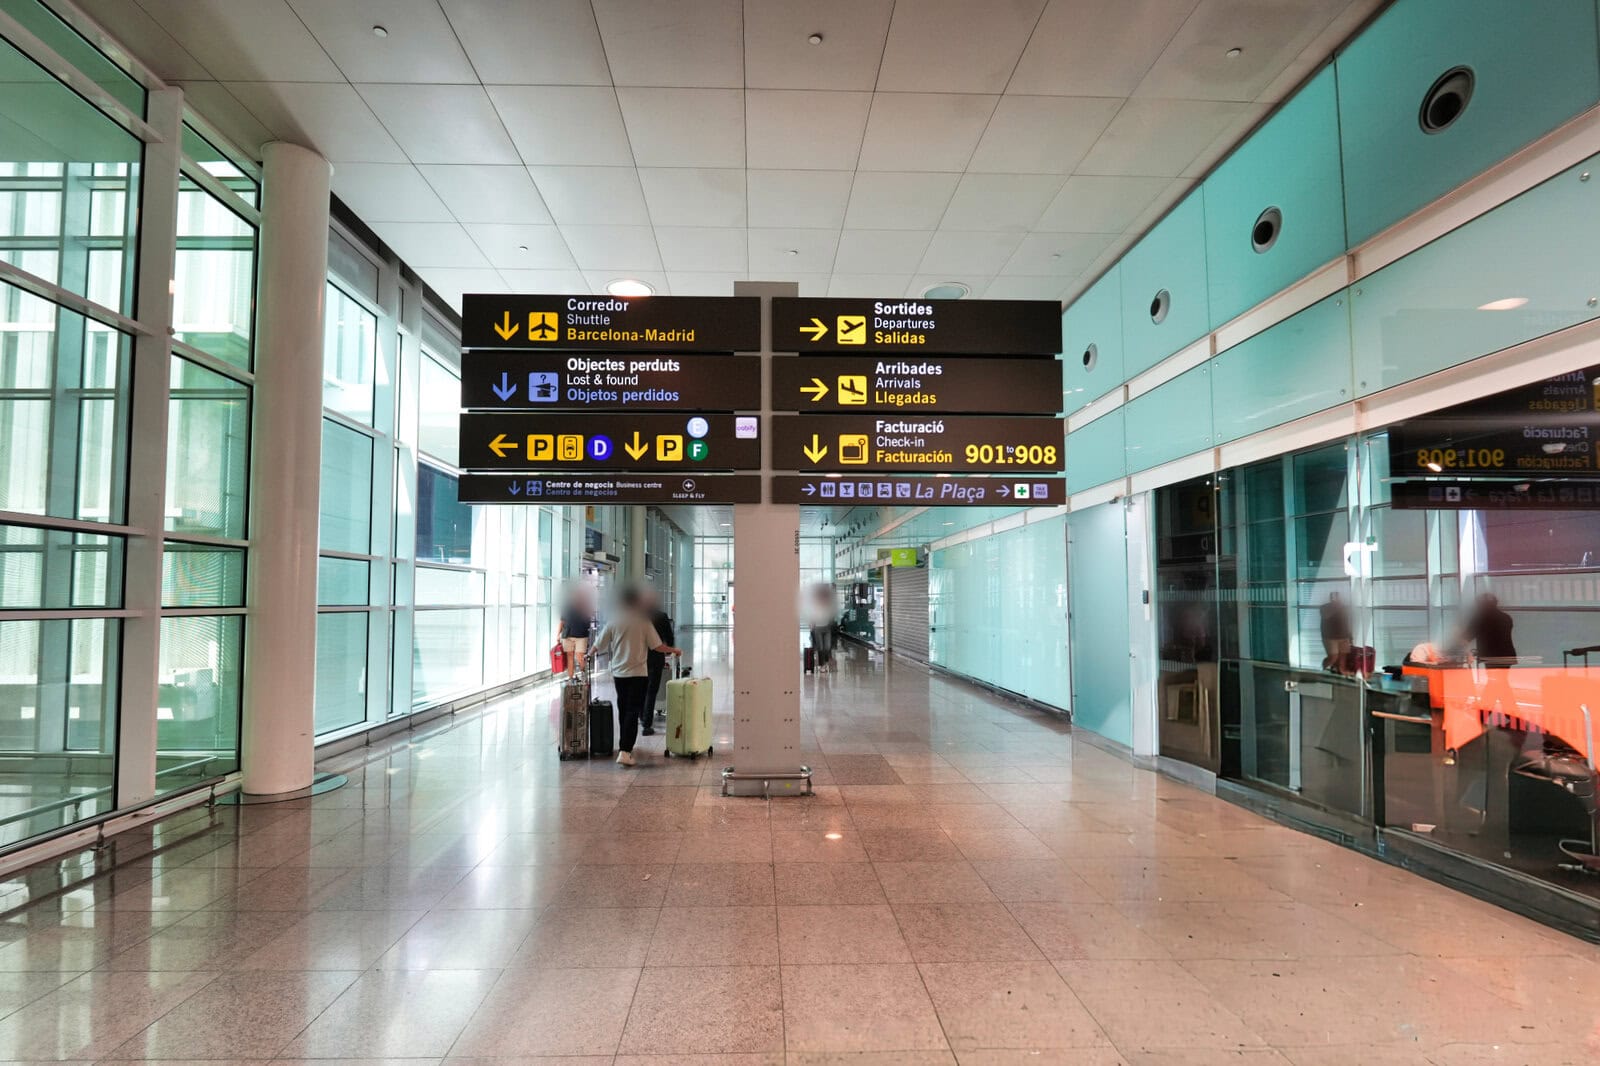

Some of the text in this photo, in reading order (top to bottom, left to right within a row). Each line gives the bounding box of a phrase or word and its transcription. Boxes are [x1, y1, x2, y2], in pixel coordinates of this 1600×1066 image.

[567, 298, 629, 311] Corredor
[875, 302, 932, 315] Sortides
[567, 314, 610, 325] Shuttle
[875, 317, 935, 330] Departures
[567, 328, 695, 342] Barcelona-Madrid
[875, 331, 925, 344] Salidas
[567, 358, 680, 373] Objectes perduts
[875, 362, 942, 375] Arribades
[567, 373, 638, 385] Lost & found
[876, 377, 920, 388] Arrivals
[567, 388, 679, 403] Objetos perdidos
[876, 391, 936, 406] Llegadas
[876, 420, 944, 433] Facturació
[534, 439, 608, 456] P D
[664, 440, 676, 456] P
[877, 436, 924, 447] Check-in
[692, 443, 702, 457] F
[877, 450, 952, 463] Facturación
[966, 445, 1005, 463] 901
[1015, 445, 1056, 464] 908
[915, 483, 985, 502] La Plaça
